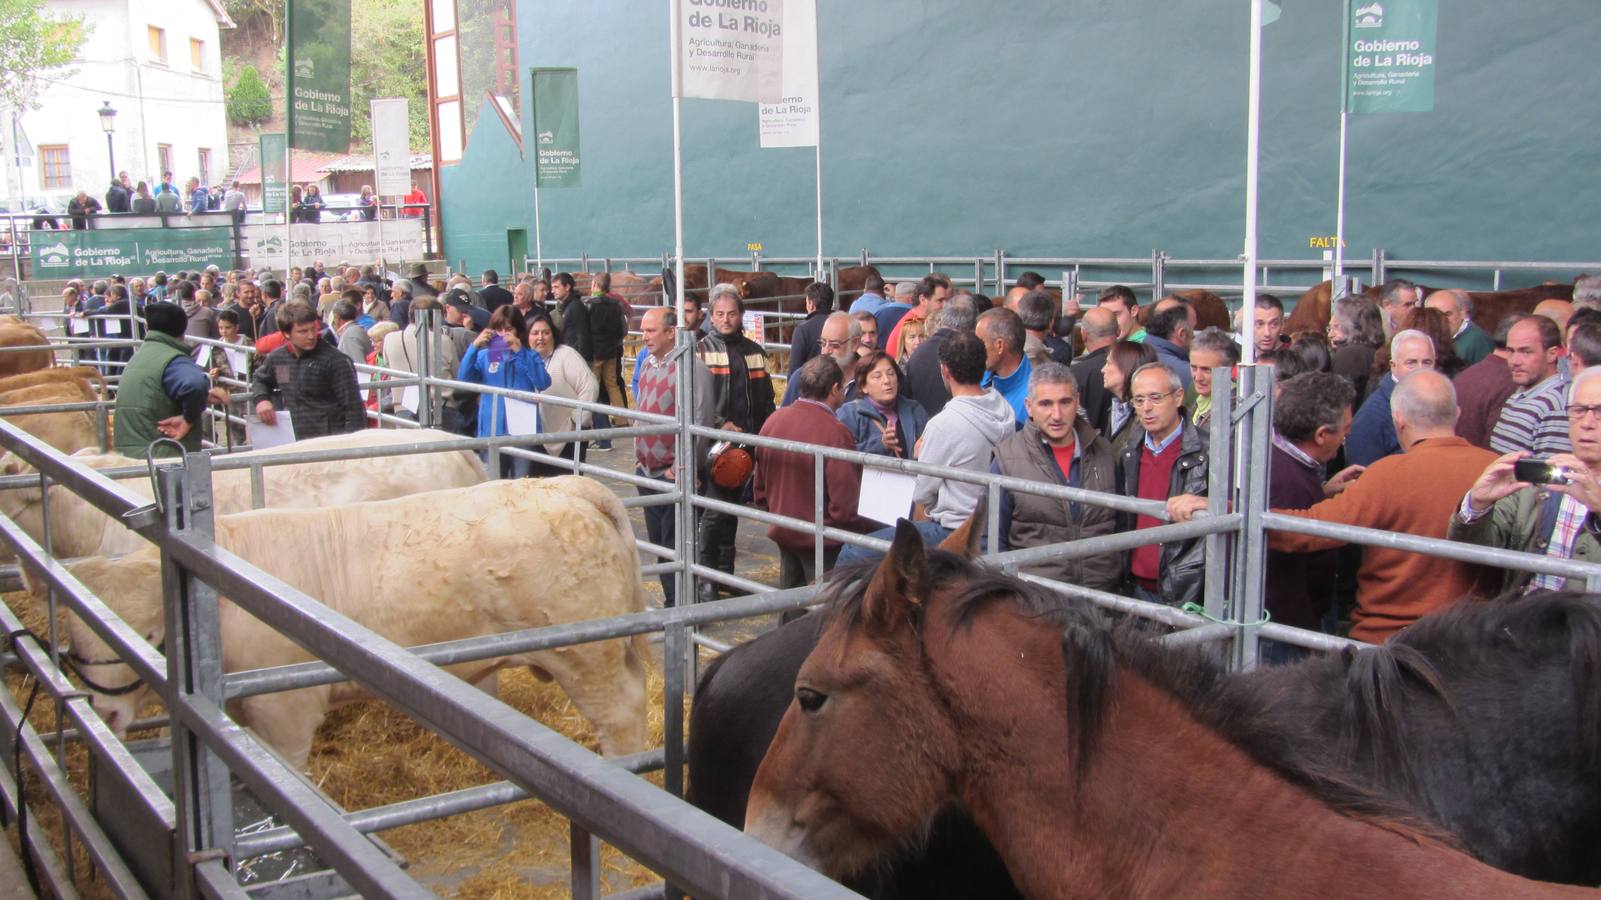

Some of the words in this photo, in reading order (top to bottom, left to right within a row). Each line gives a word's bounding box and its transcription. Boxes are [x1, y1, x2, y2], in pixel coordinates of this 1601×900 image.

[688, 10, 713, 29] de
[718, 12, 739, 31] La
[743, 15, 781, 38] Rioja
[688, 37, 734, 50] Agricultura,
[1354, 40, 1419, 52] Gobierno
[688, 49, 695, 58] y
[696, 48, 735, 59] Desarrollo
[736, 51, 756, 62] Rural
[1353, 55, 1371, 67] de
[1375, 54, 1392, 67] La
[1396, 53, 1432, 67] Rioja
[295, 87, 341, 102] Gobierno
[295, 100, 308, 110] de
[311, 101, 323, 112] La
[325, 103, 349, 116] Rioja
[761, 106, 774, 115] de
[775, 105, 787, 114] La
[789, 104, 812, 115] Rioja
[561, 157, 580, 165] Rioja
[74, 248, 121, 256] Gobierno
[75, 258, 88, 266] de
[90, 257, 103, 265] La
[105, 256, 131, 266] Rioja
